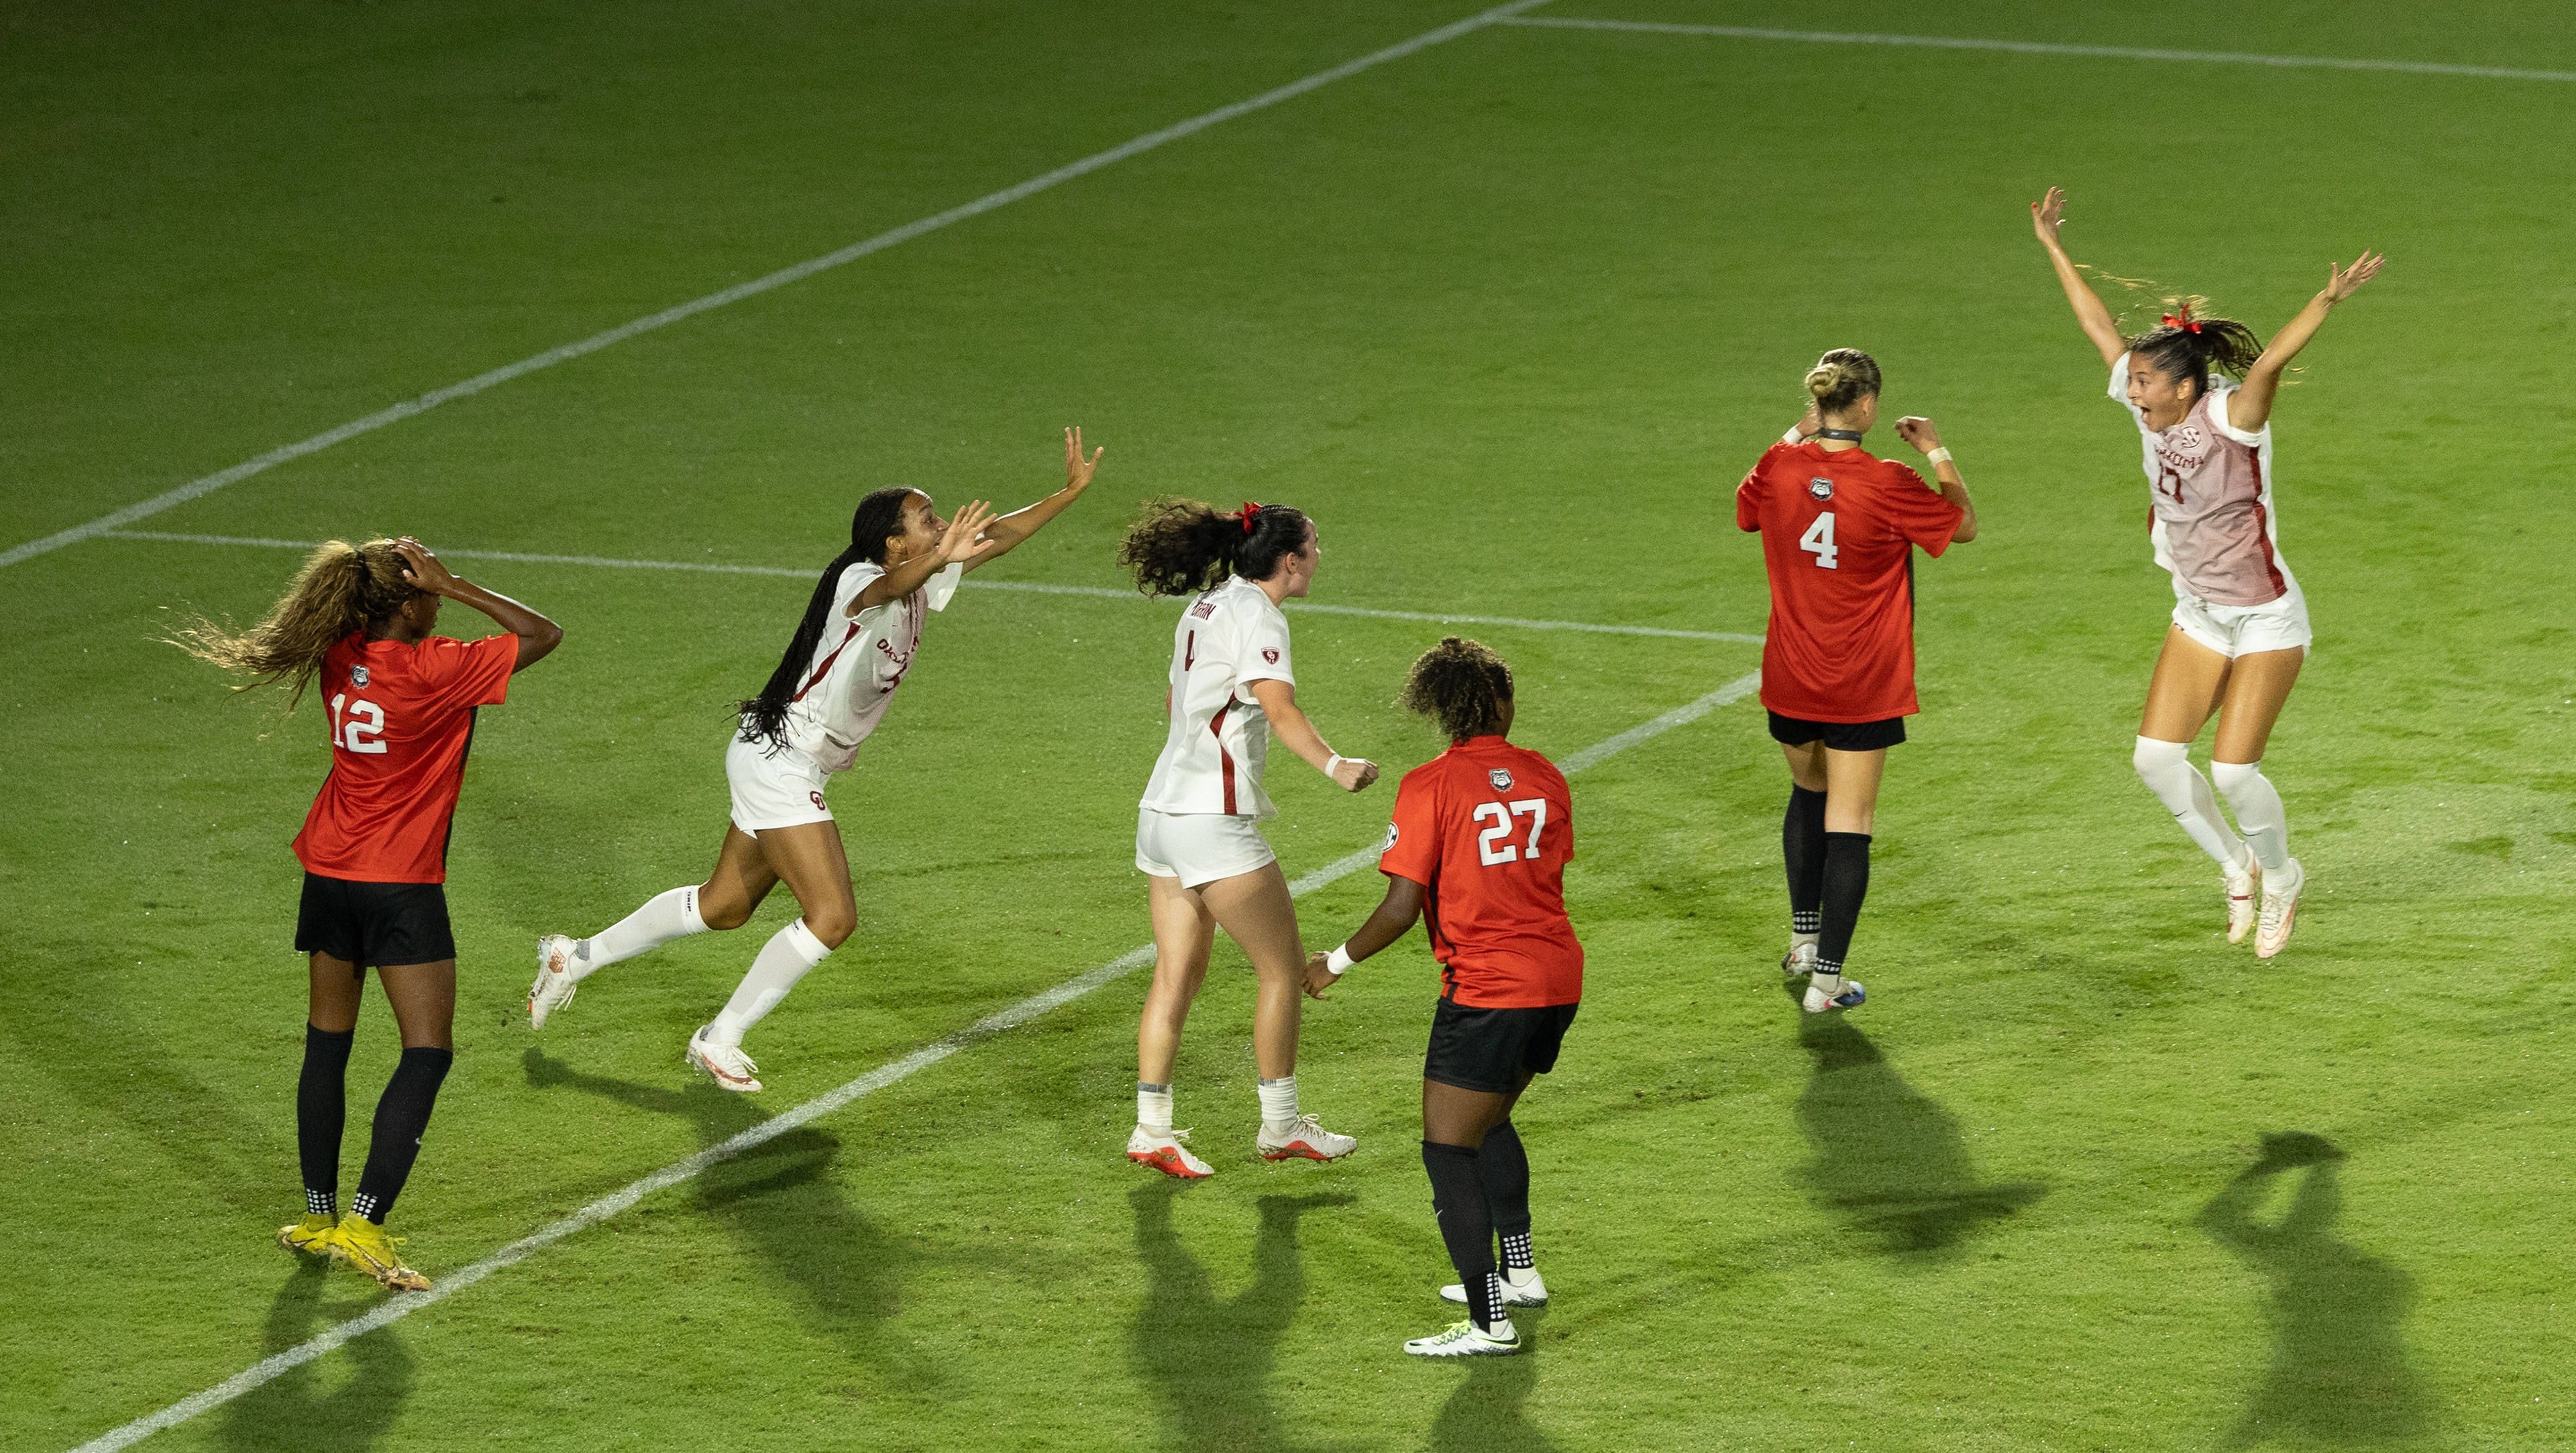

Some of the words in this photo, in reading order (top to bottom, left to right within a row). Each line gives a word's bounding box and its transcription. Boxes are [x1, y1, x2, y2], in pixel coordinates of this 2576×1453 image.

[1799, 510, 1838, 570] 4
[331, 693, 388, 753] 12
[1472, 798, 1547, 867] 27
